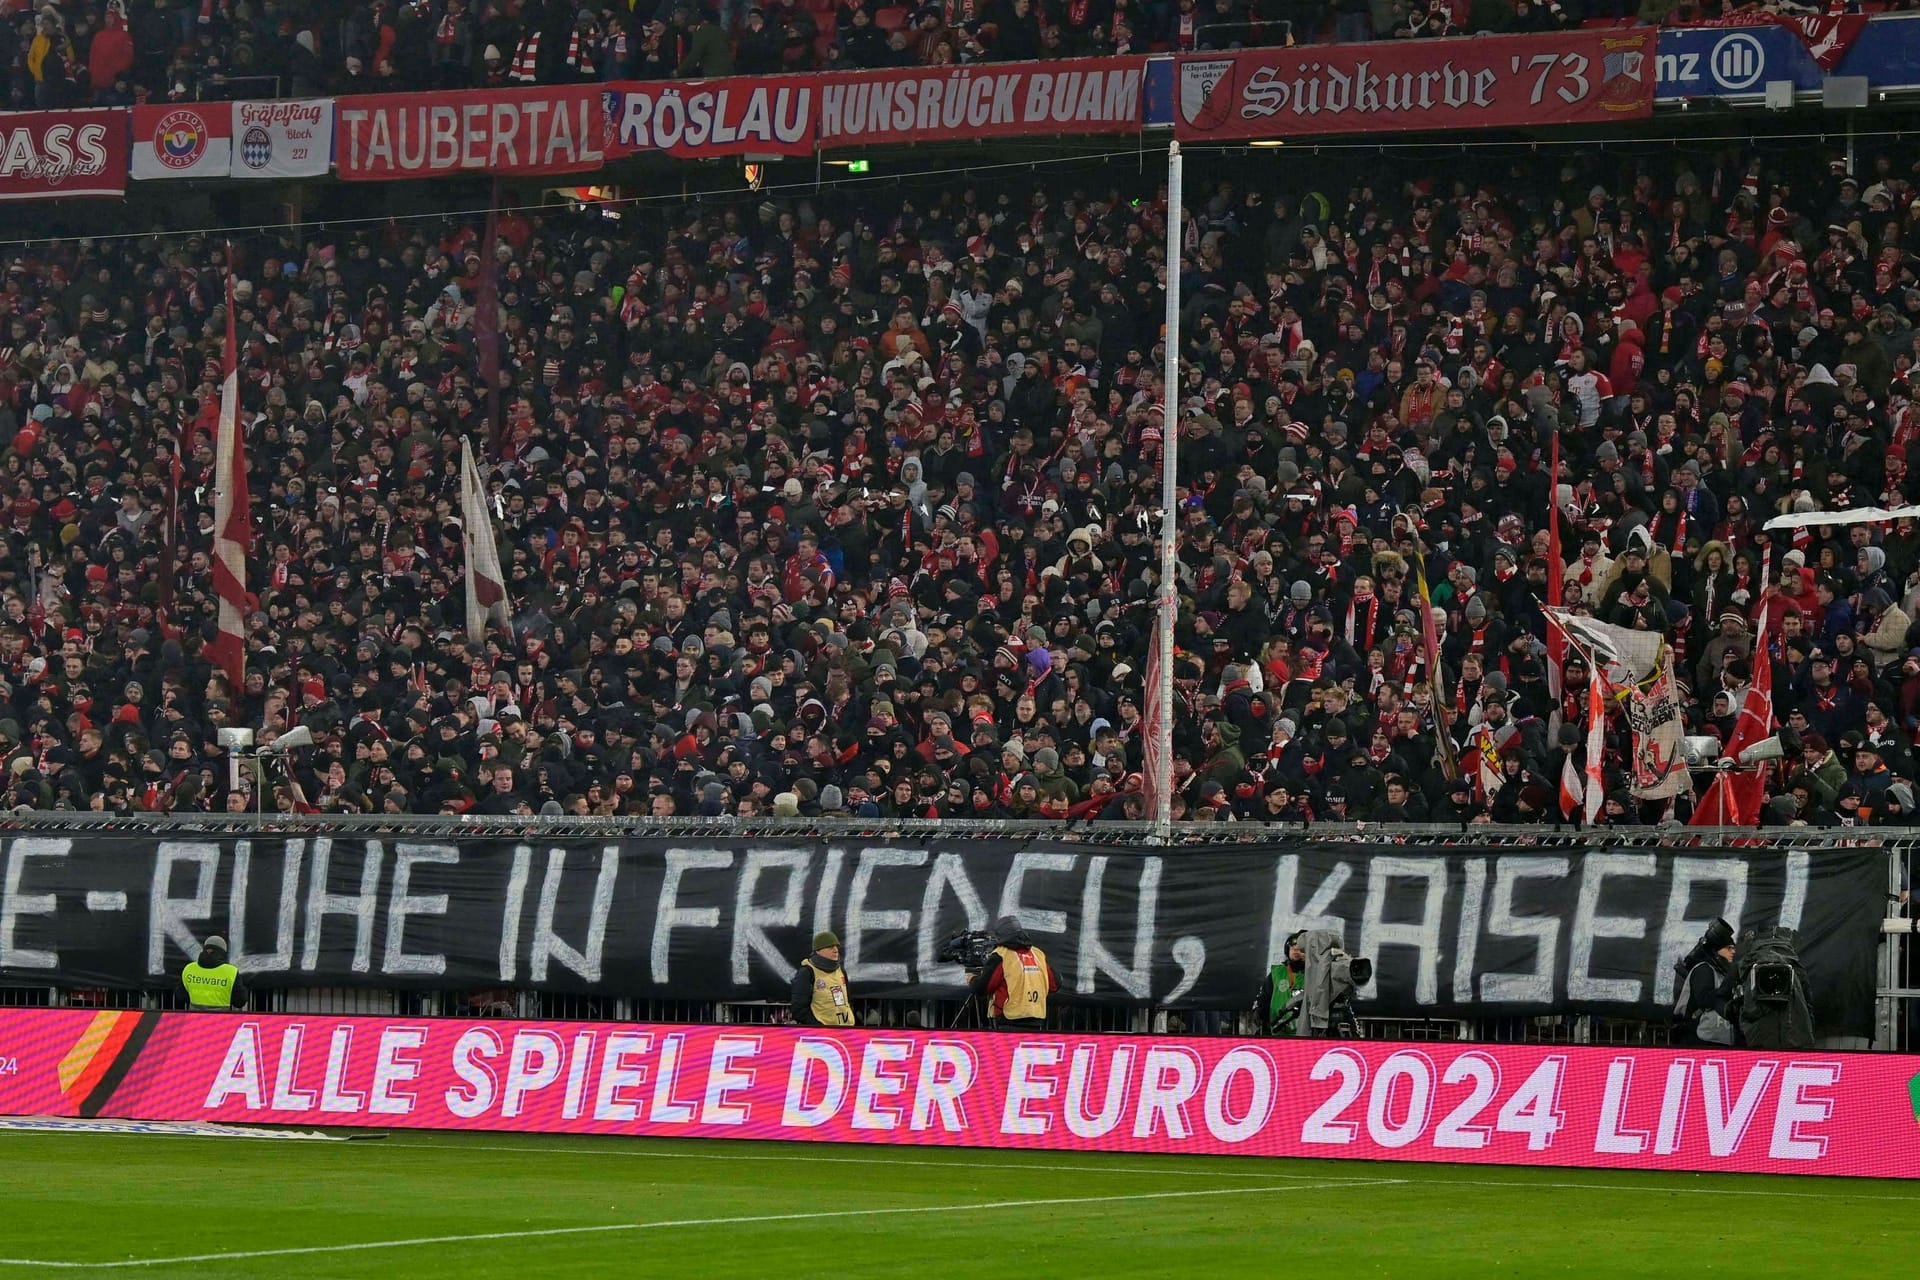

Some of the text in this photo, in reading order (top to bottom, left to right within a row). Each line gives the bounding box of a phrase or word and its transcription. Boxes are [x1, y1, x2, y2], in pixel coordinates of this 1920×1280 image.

[821, 69, 1141, 138] HUNSRÜCK BUAM
[1241, 53, 1590, 120] Südkurve '73
[158, 111, 204, 135] SEKTION
[240, 103, 321, 127] Gräfelfing
[286, 128, 312, 140] Block
[342, 99, 604, 171] TAUBERTAL
[618, 87, 811, 150] RÖSLAU
[20, 154, 107, 186] Bayern
[161, 152, 199, 166] KIOSK
[148, 838, 459, 975] RUHE
[500, 846, 619, 982] IN
[651, 848, 1206, 1004] FRIEDEN,
[186, 973, 228, 987] Steward
[203, 1022, 1842, 1160] ALLE SPIELE DER EURO 2024 LIVE
